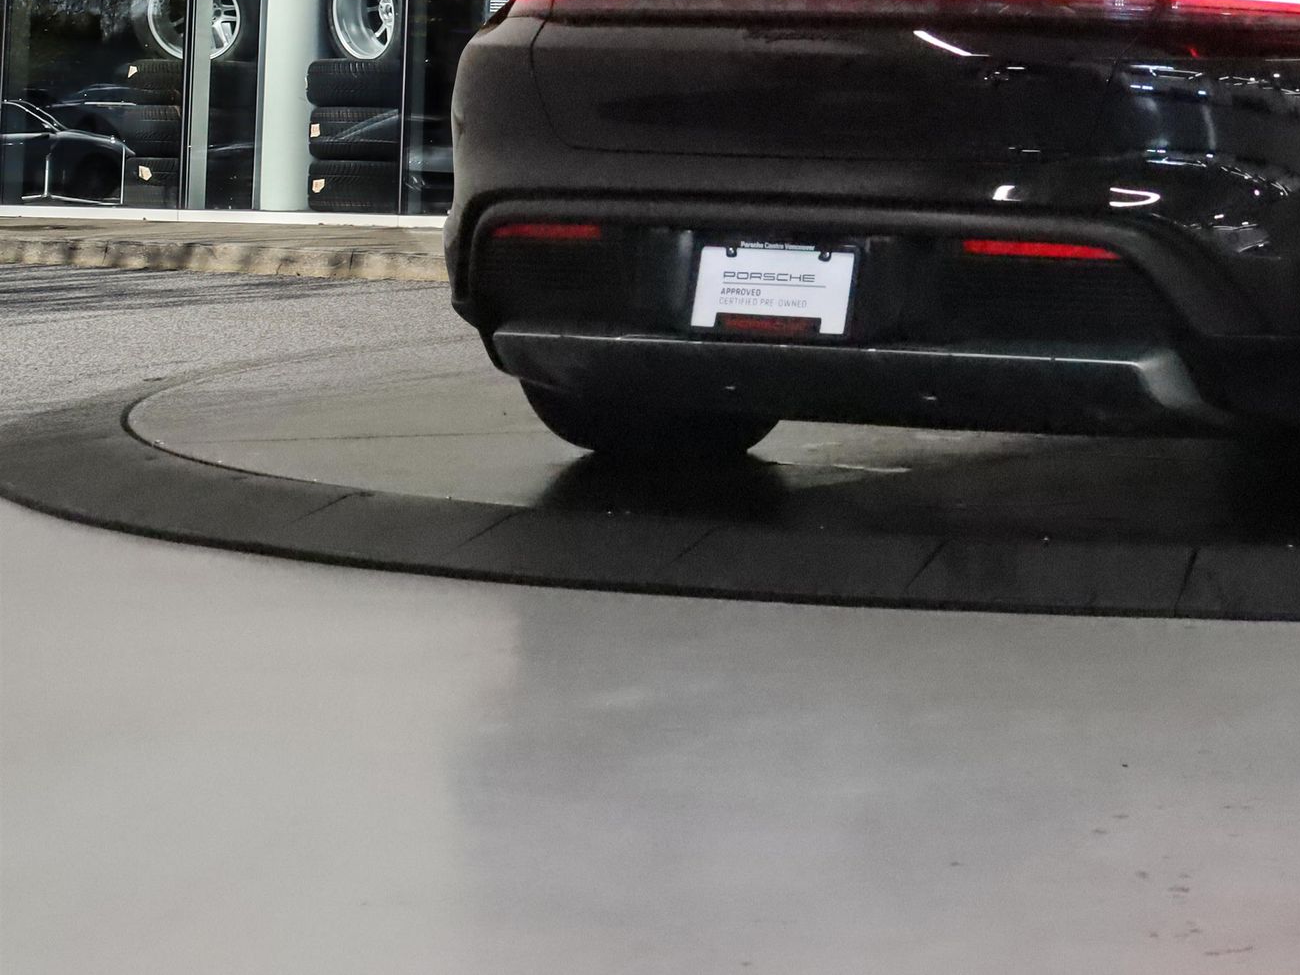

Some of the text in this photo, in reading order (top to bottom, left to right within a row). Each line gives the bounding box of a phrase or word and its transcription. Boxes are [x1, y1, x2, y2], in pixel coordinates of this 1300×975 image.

[723, 271, 816, 283] PORSCHE
[720, 287, 761, 297] APPROVED
[719, 296, 758, 306] CERTIFIED
